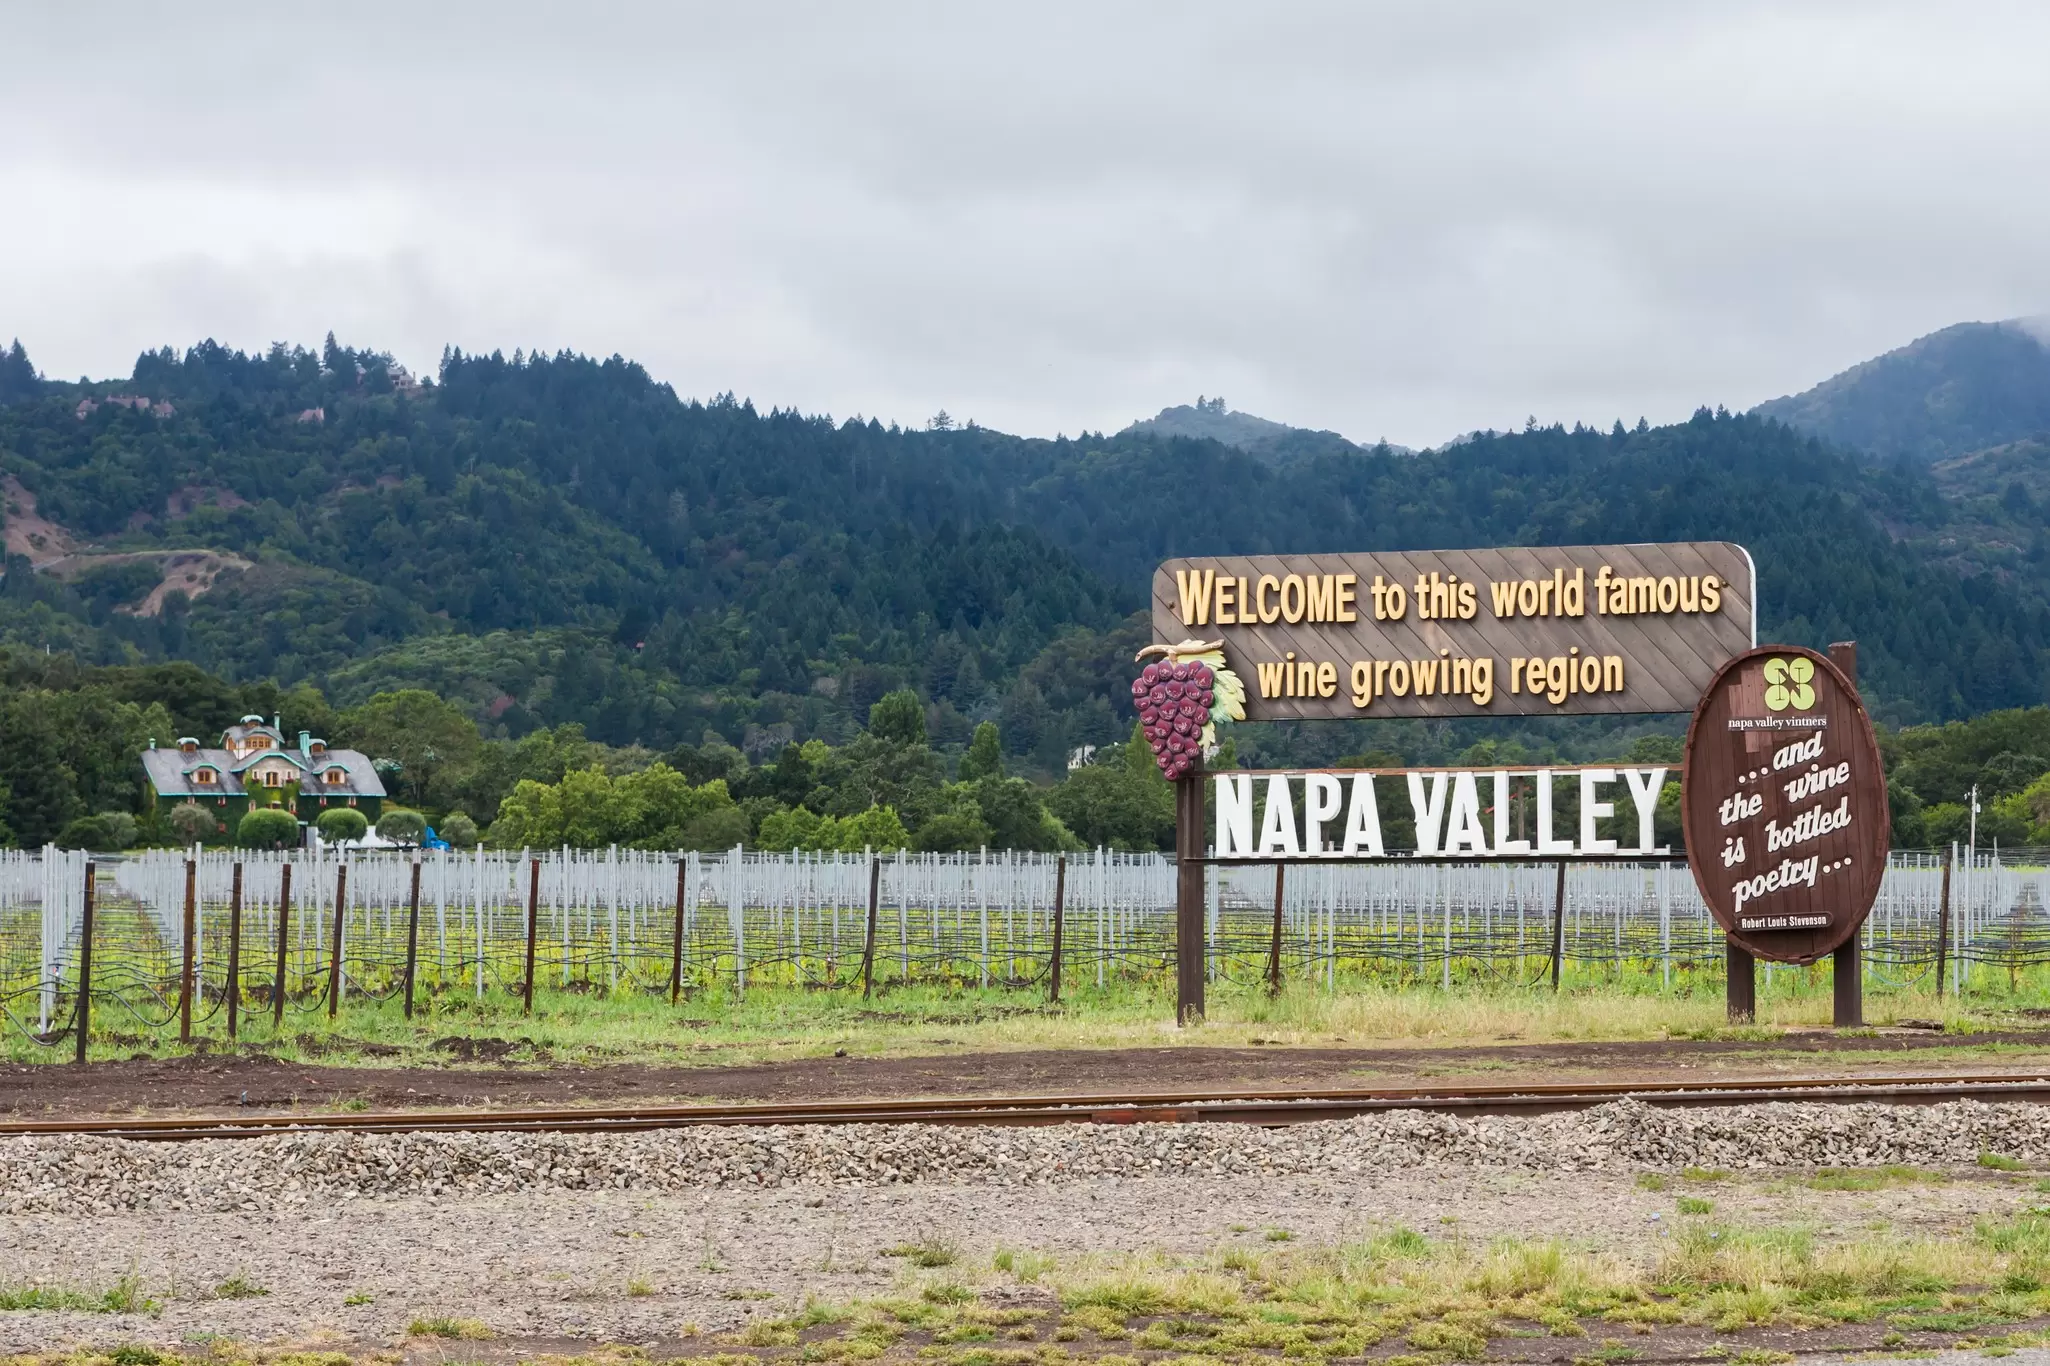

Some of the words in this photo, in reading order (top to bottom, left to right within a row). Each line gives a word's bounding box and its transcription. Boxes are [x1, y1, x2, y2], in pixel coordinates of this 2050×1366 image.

[1175, 568, 1357, 626] WELCOME
[1371, 575, 1406, 621] to
[1414, 571, 1477, 620] this
[1490, 567, 1585, 619] world
[1594, 565, 1721, 615] famous
[1257, 652, 1337, 699] wine
[1351, 648, 1493, 708] growing
[1511, 647, 1624, 705] region
[1728, 719, 1753, 731] napa
[1755, 716, 1784, 729] valley
[1784, 716, 1827, 727] vintners
[1215, 772, 1385, 858] NAPA
[1406, 767, 1668, 857] VALLEY
[1718, 792, 1763, 826] the
[1783, 761, 1850, 803] wine
[1720, 836, 1746, 868] is
[1764, 796, 1852, 853] bottled
[1741, 918, 1766, 929] Robert
[1767, 916, 1787, 927] Louis
[1789, 915, 1827, 926] Stevenson
